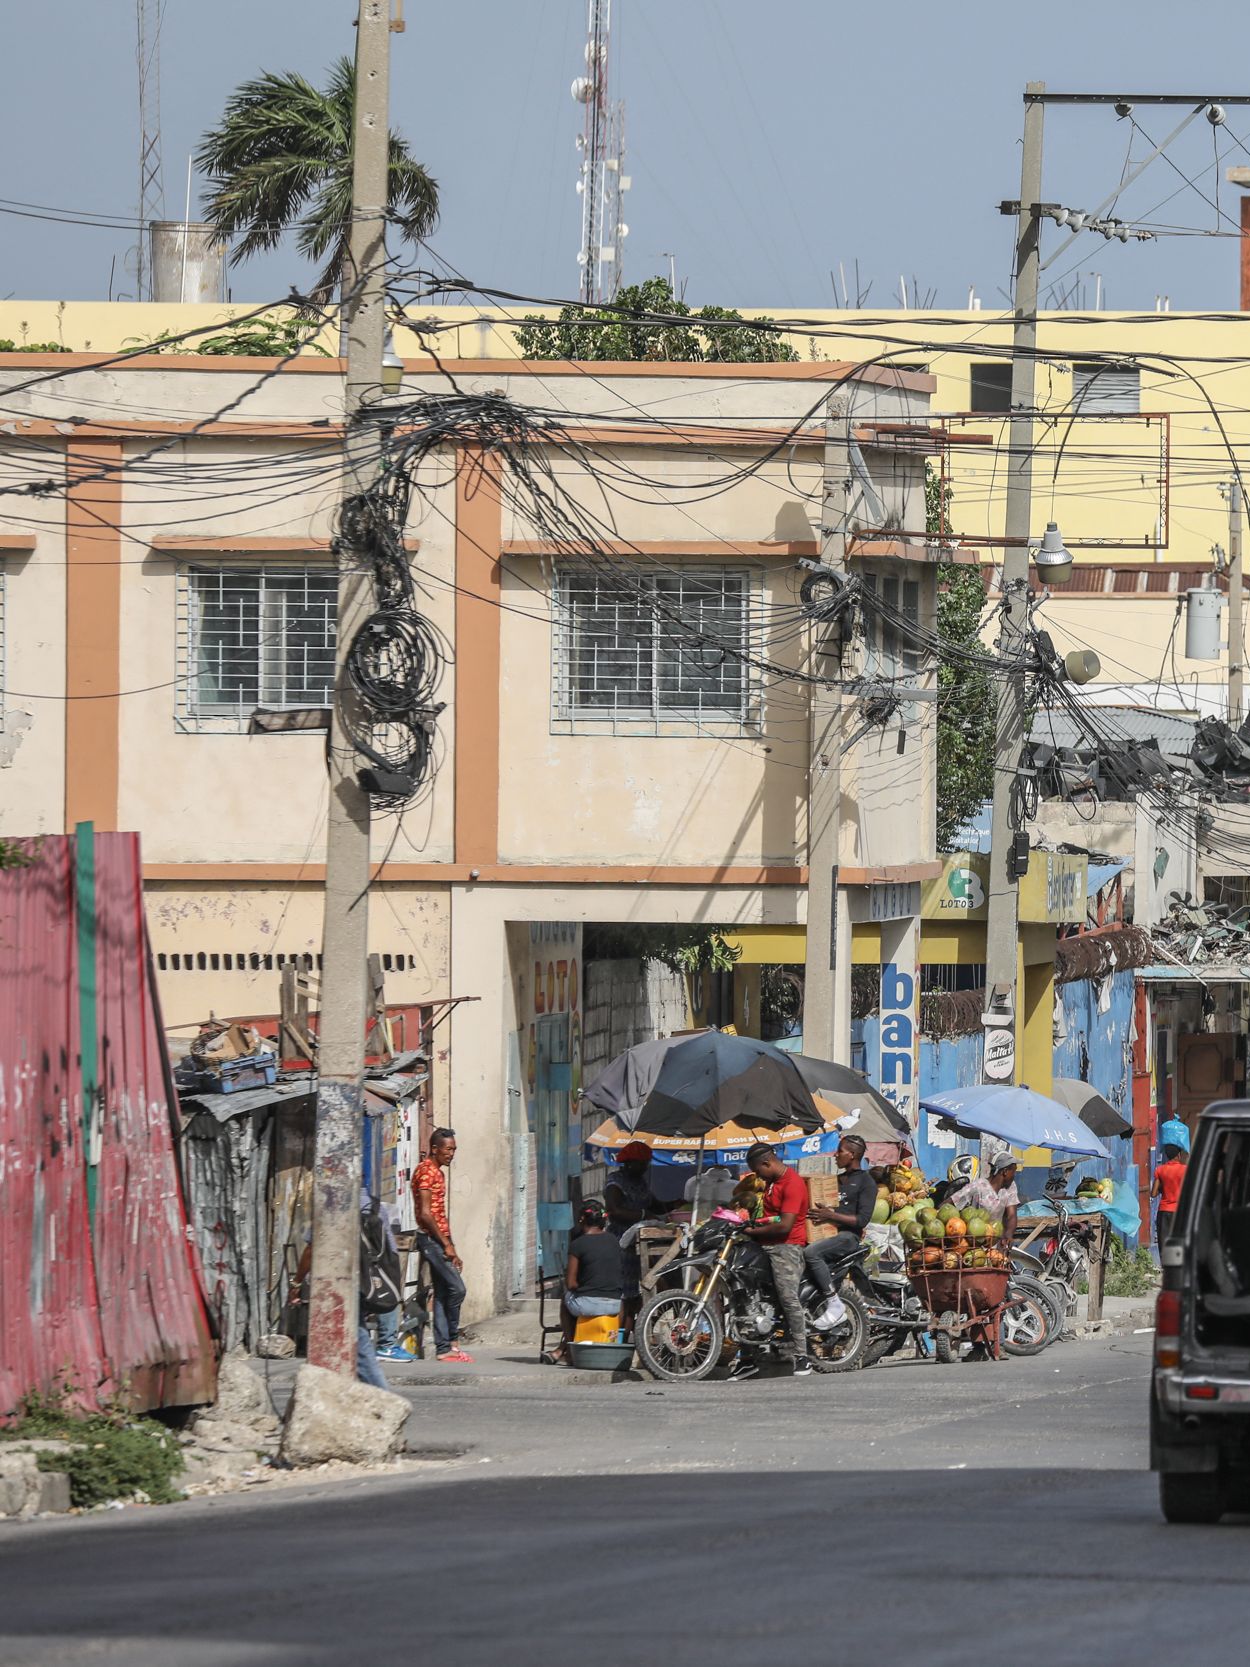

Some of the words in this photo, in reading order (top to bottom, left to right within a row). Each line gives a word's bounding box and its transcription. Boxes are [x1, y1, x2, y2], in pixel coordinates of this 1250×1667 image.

[534, 958, 578, 1014] LOTO
[684, 1138, 717, 1146] RAPDE
[801, 1136, 821, 1153] 4G
